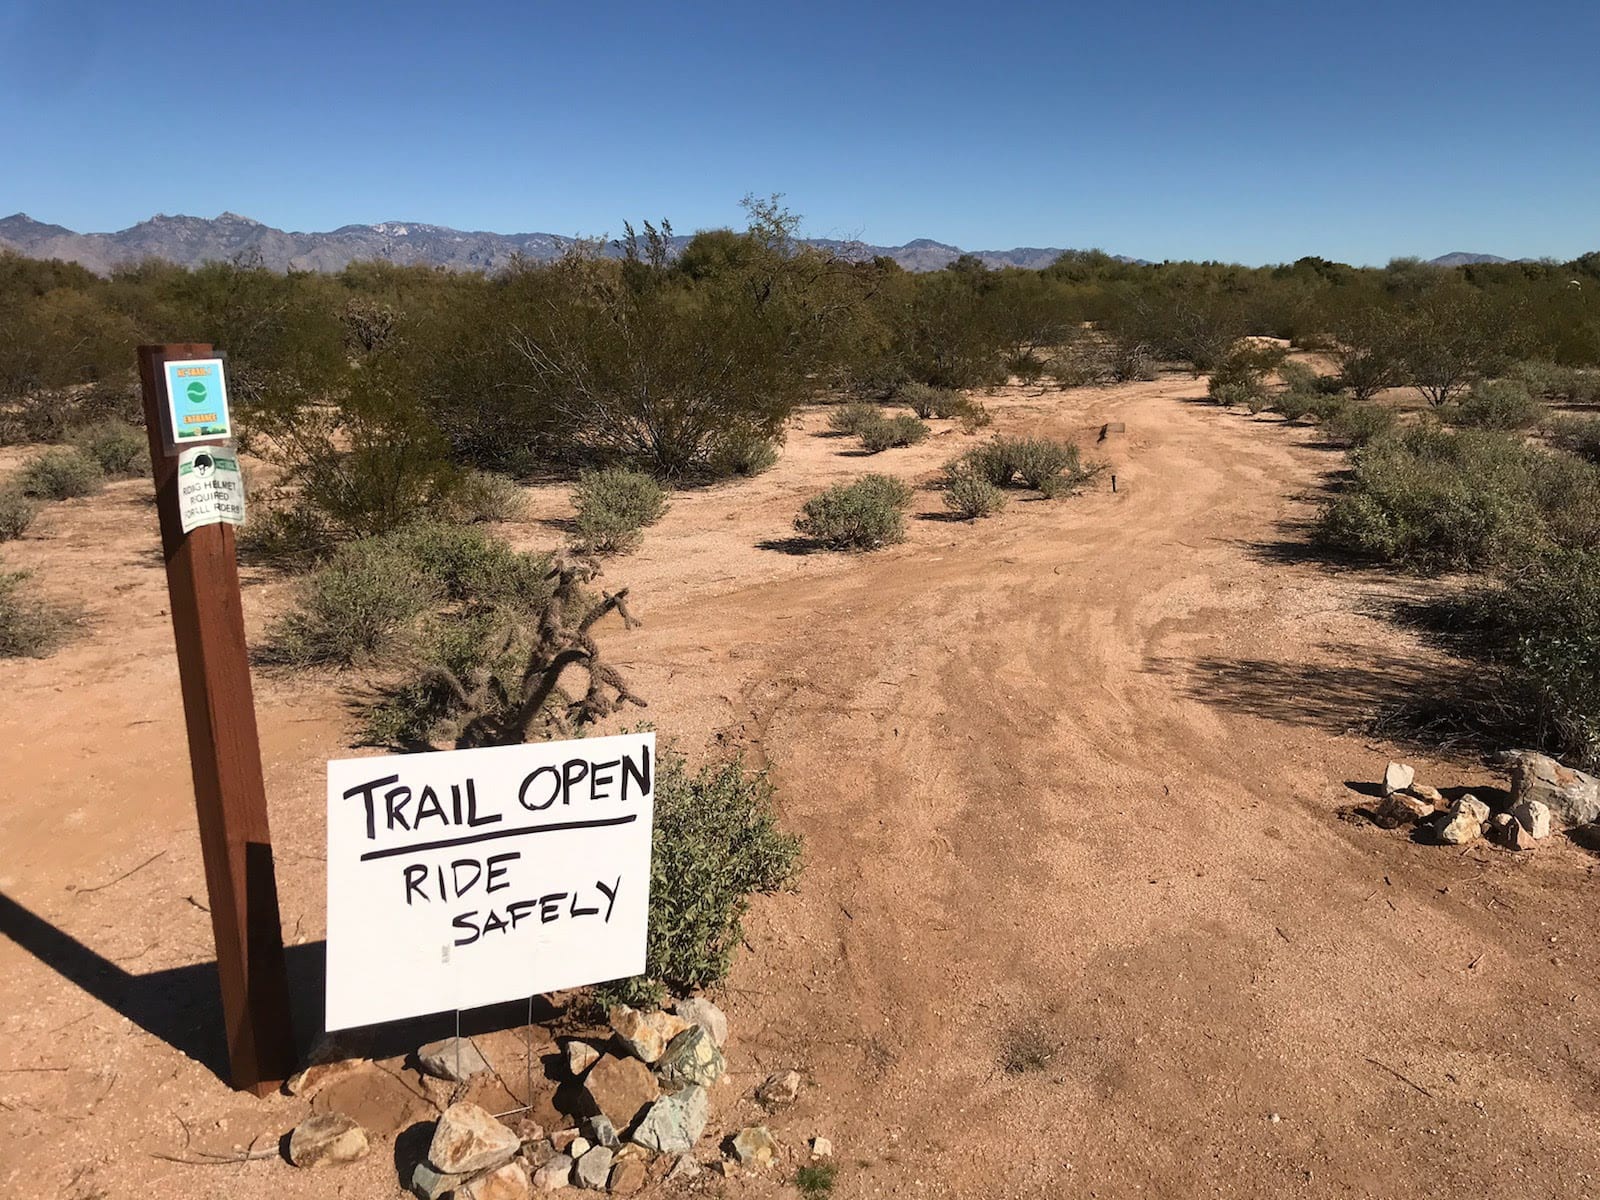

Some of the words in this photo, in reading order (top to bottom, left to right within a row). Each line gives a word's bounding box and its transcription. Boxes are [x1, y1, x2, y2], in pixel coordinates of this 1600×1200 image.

[183, 413, 217, 424] ENTRANCE
[203, 480, 236, 491] HELMET
[343, 774, 503, 840] TRAIL
[518, 745, 651, 811] OPEN
[403, 852, 521, 905] RIDE
[452, 875, 622, 947] SAFELY
